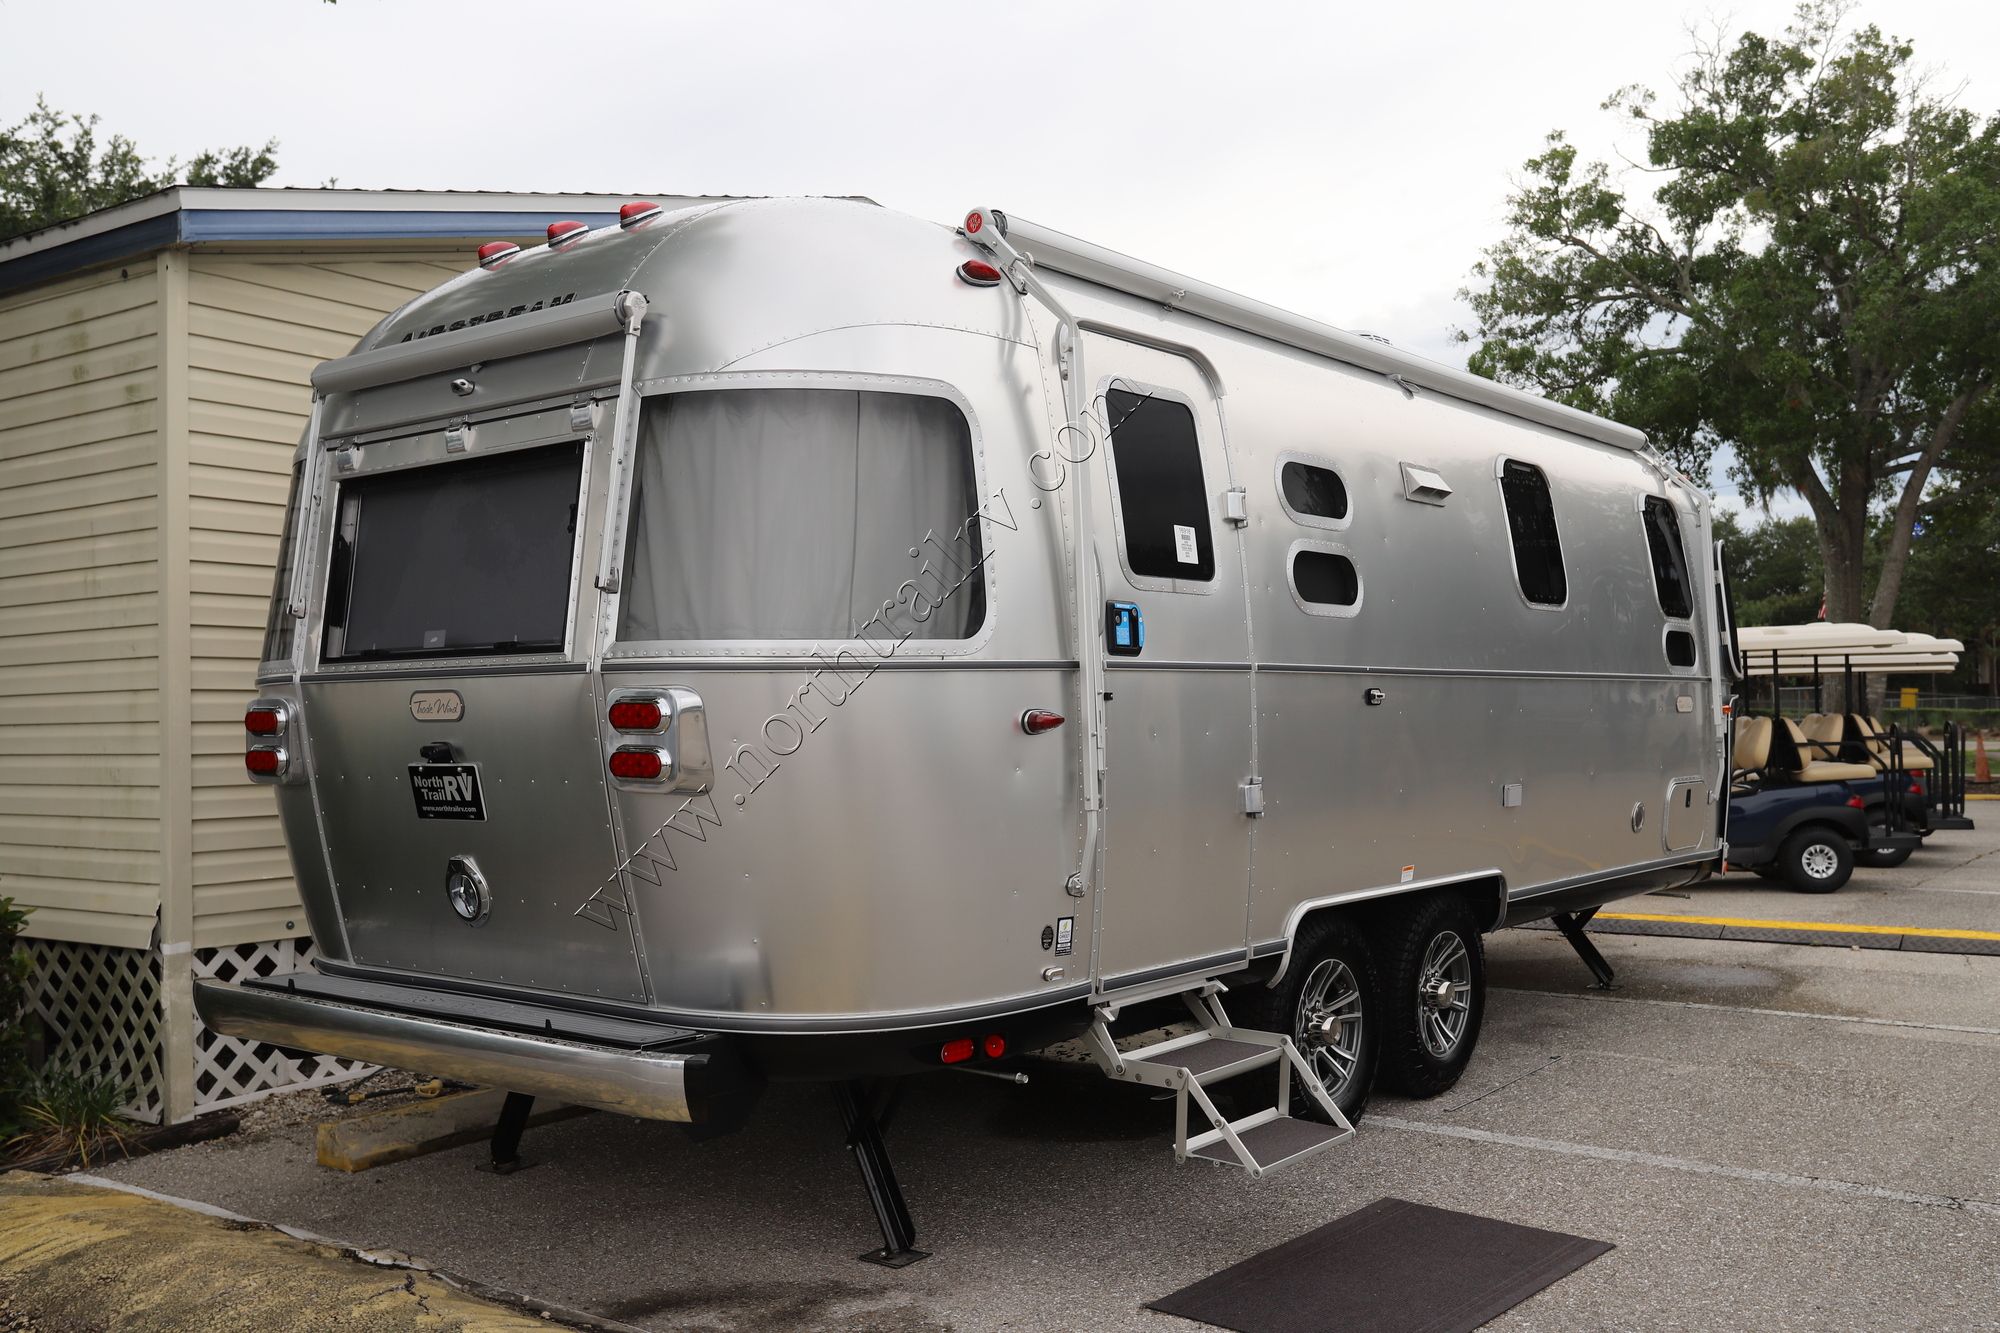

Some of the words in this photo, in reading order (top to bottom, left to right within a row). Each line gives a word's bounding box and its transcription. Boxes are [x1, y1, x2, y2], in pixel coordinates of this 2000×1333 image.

[433, 699, 458, 714] Wind
[414, 775, 443, 788] North
[442, 772, 473, 801] RV
[421, 789, 446, 801] Trail
[422, 805, 477, 813] www.northtrailrv.com
